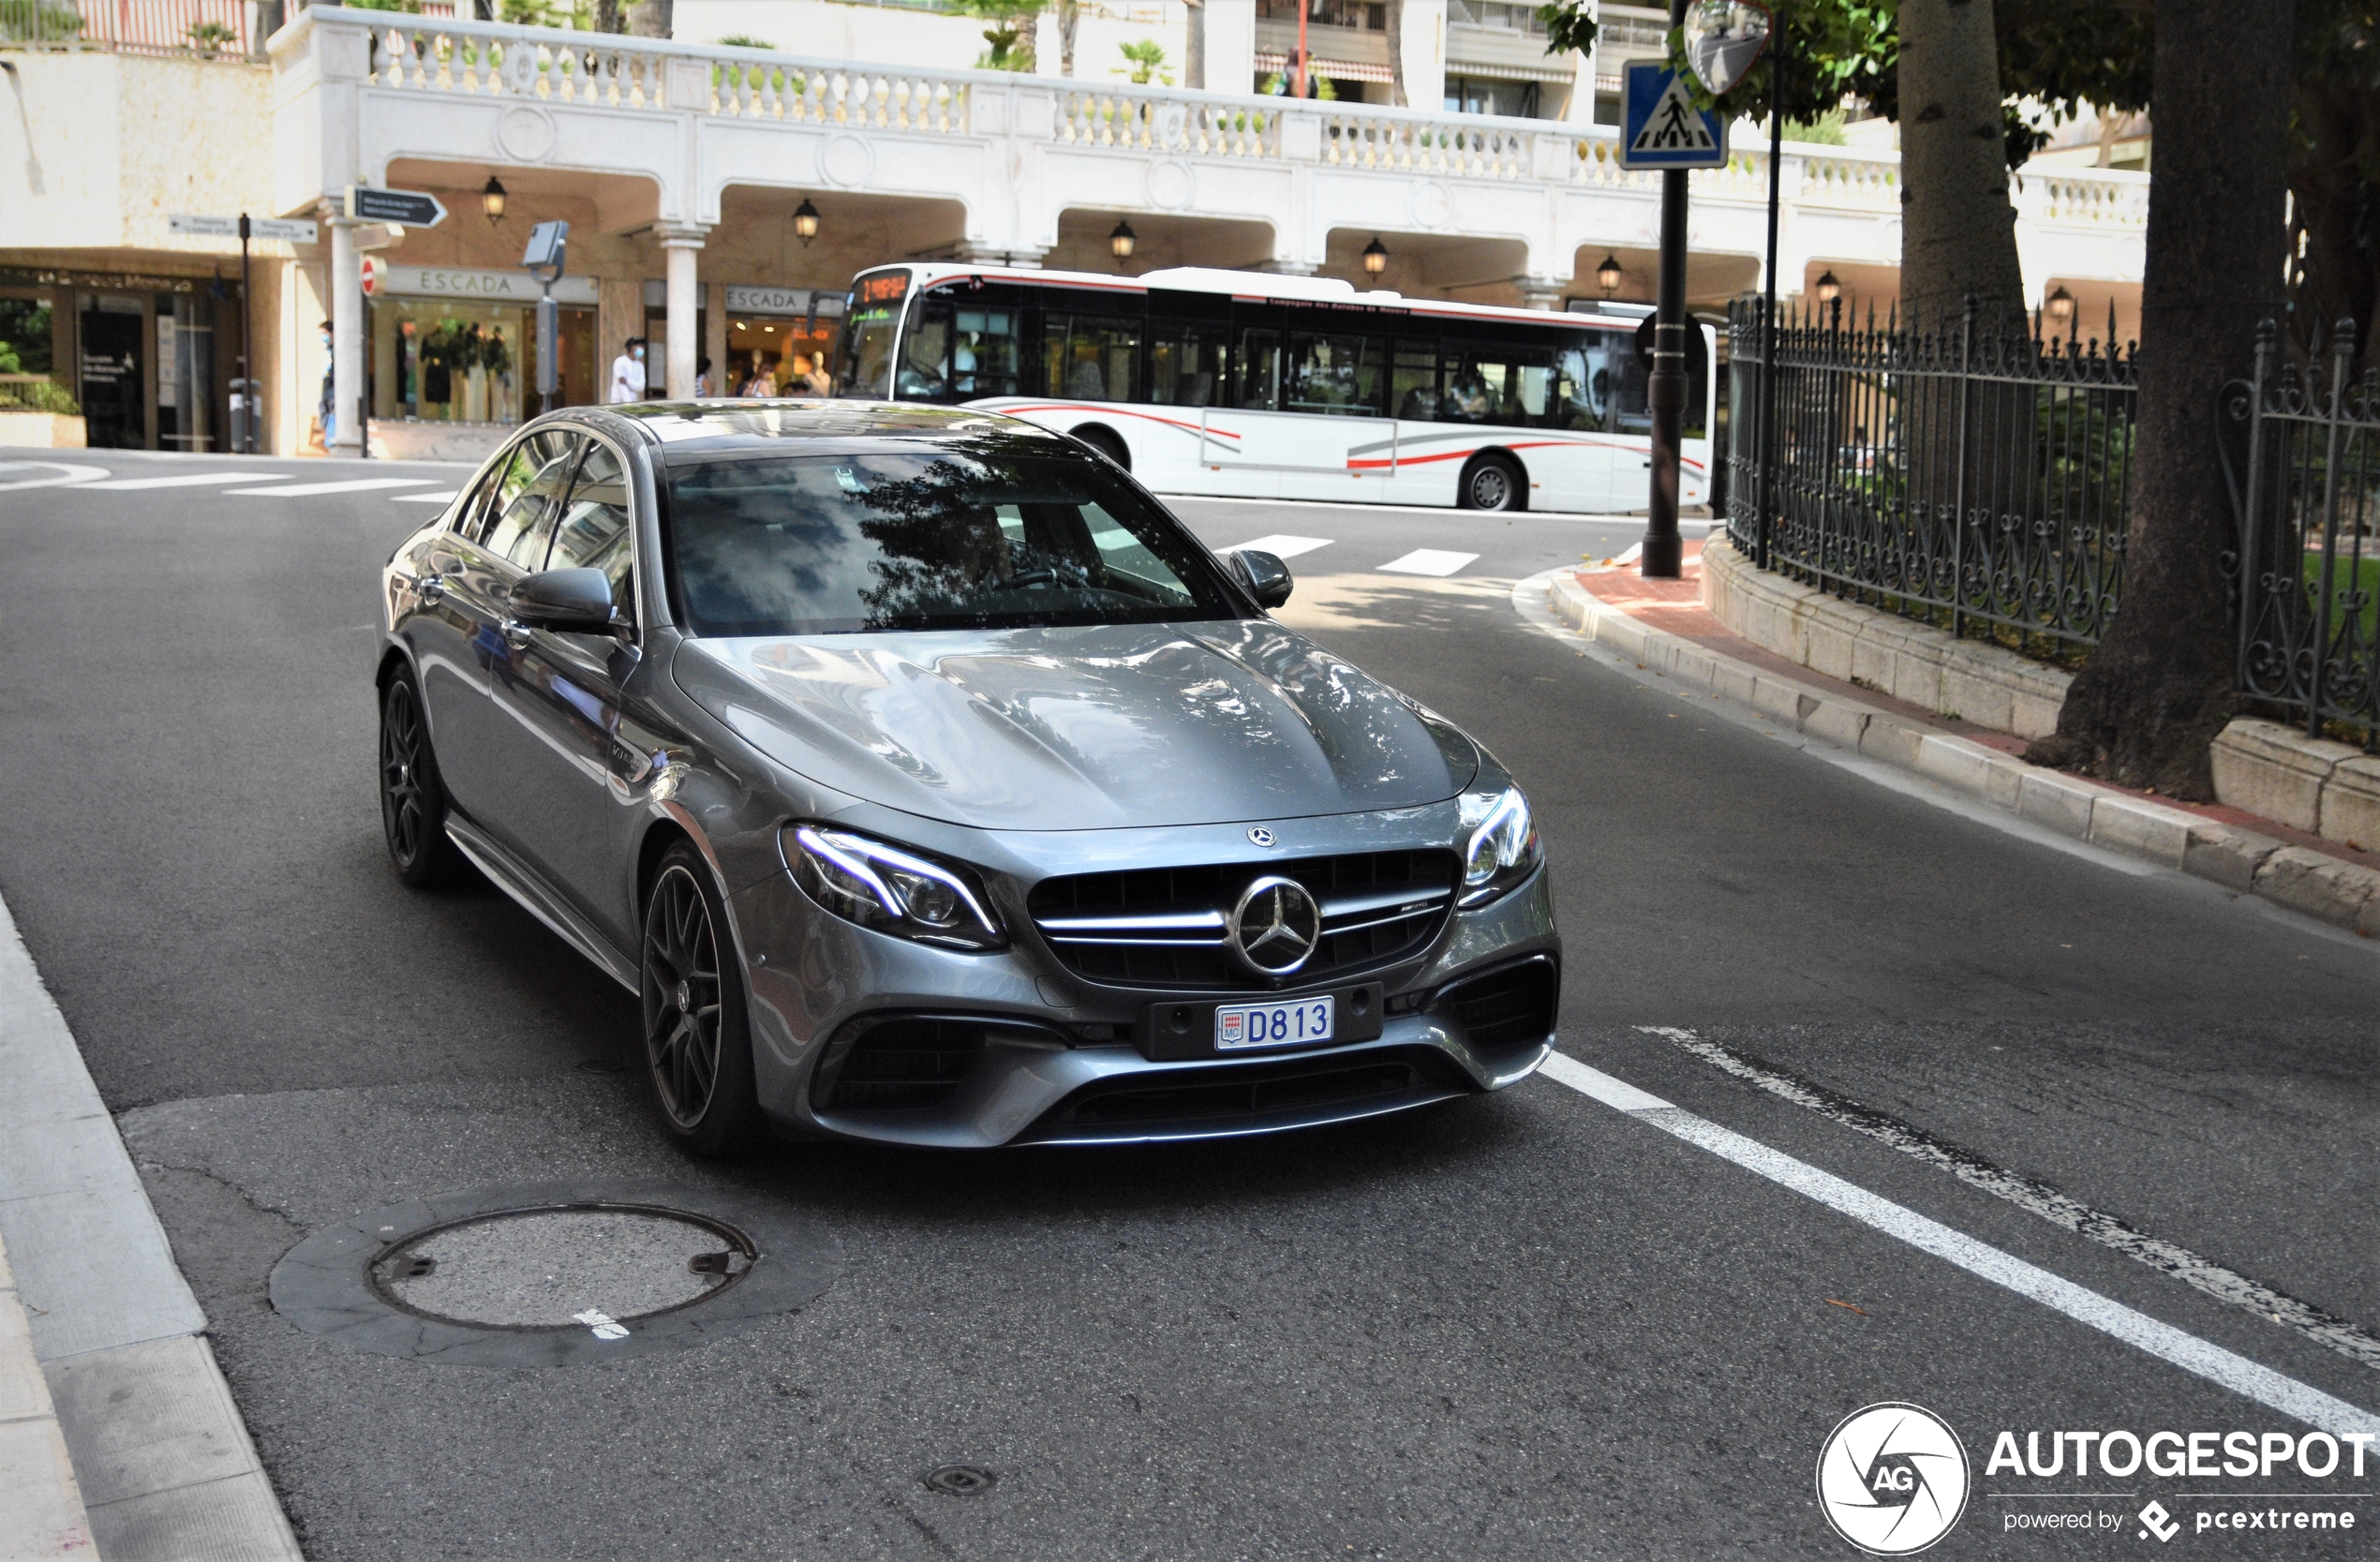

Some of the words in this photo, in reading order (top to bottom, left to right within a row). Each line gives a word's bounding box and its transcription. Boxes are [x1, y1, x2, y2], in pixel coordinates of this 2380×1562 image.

[420, 271, 512, 293] ESCADA
[727, 290, 797, 308] ESCADA
[1379, 306, 1408, 315] Monaco
[1225, 1028, 1239, 1037] MC
[1248, 1004, 1328, 1043] D813
